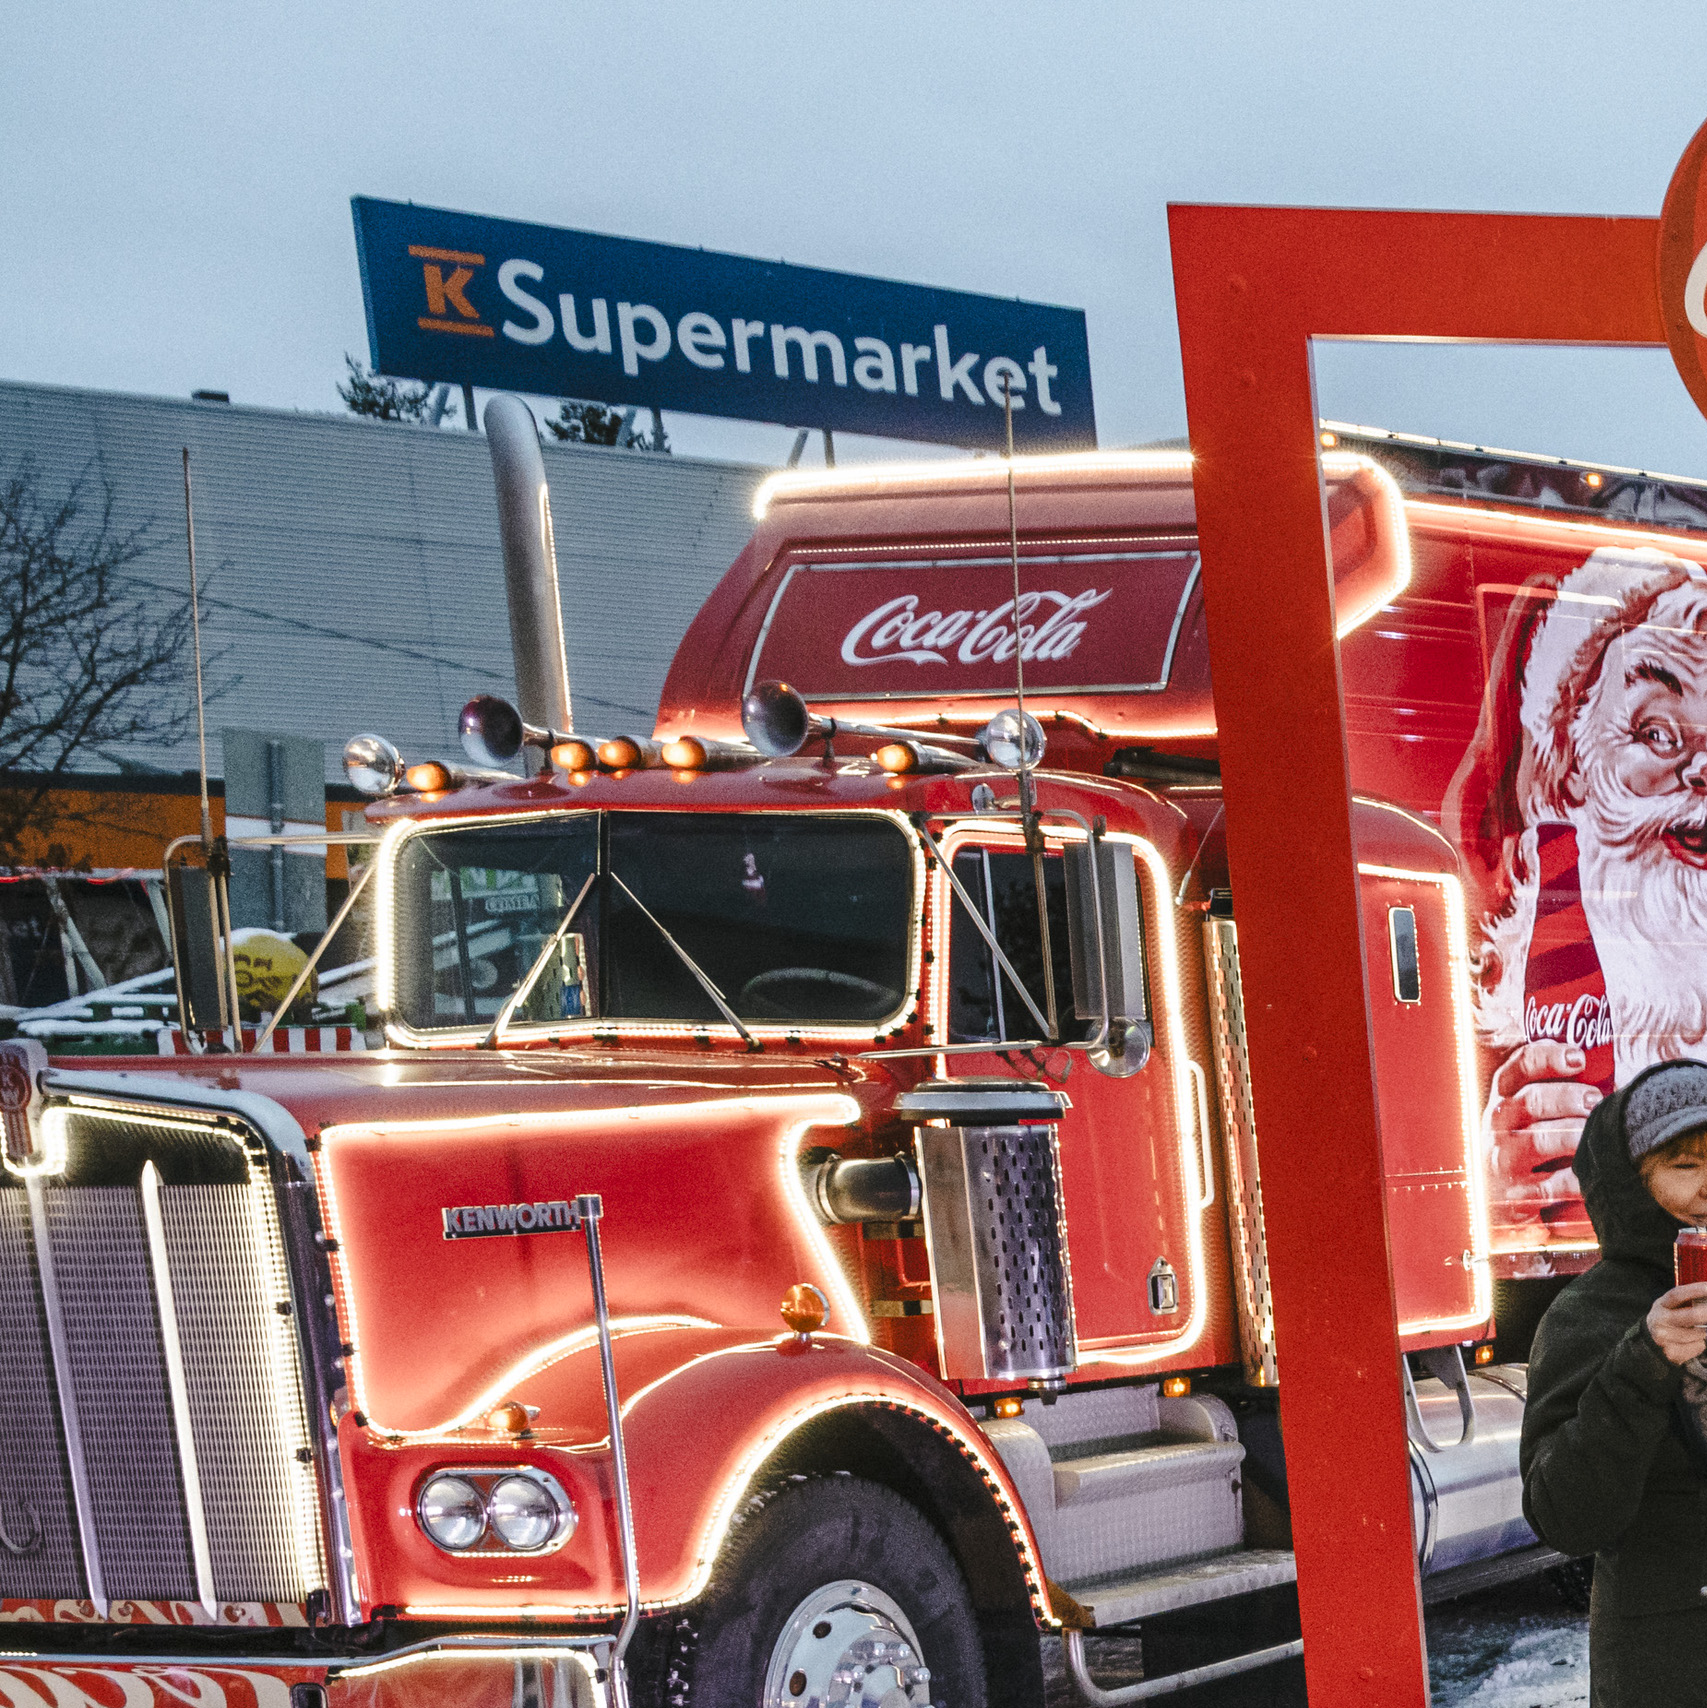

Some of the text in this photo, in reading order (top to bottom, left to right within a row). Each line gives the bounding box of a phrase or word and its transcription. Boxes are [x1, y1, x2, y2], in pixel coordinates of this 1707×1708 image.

[497, 258, 1062, 416] Supermarket
[840, 588, 1113, 666] Coca-Cola
[1525, 993, 1613, 1050] Coca-Cola
[441, 1200, 582, 1233] KENWORTH
